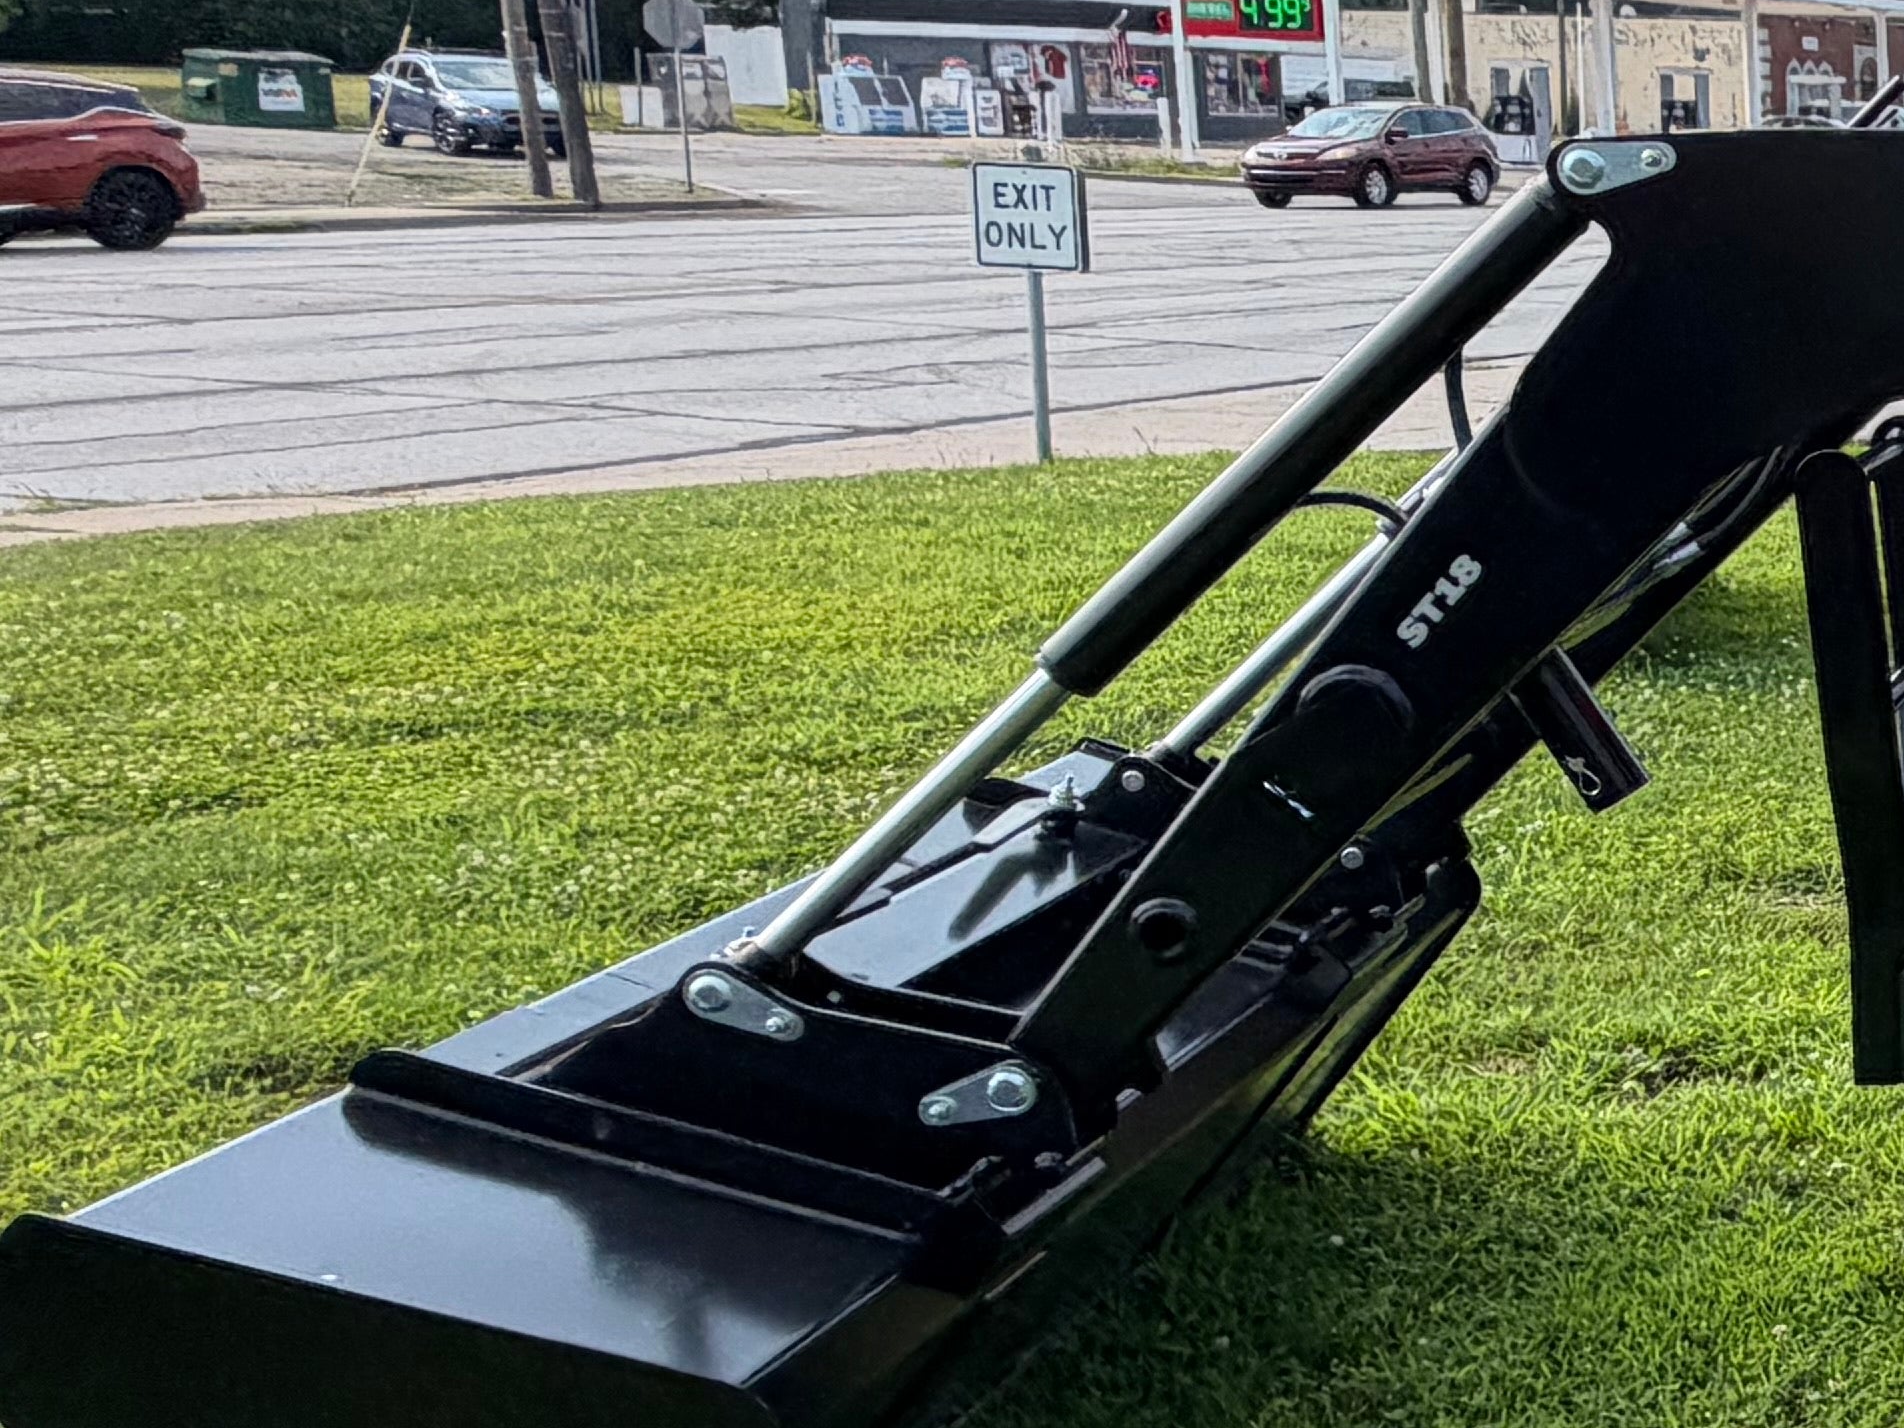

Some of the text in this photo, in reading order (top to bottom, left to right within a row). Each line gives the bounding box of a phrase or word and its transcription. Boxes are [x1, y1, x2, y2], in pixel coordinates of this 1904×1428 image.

[993, 182, 1056, 212] EXIT
[984, 220, 1067, 251] ONLY
[1396, 553, 1483, 649] ST18
